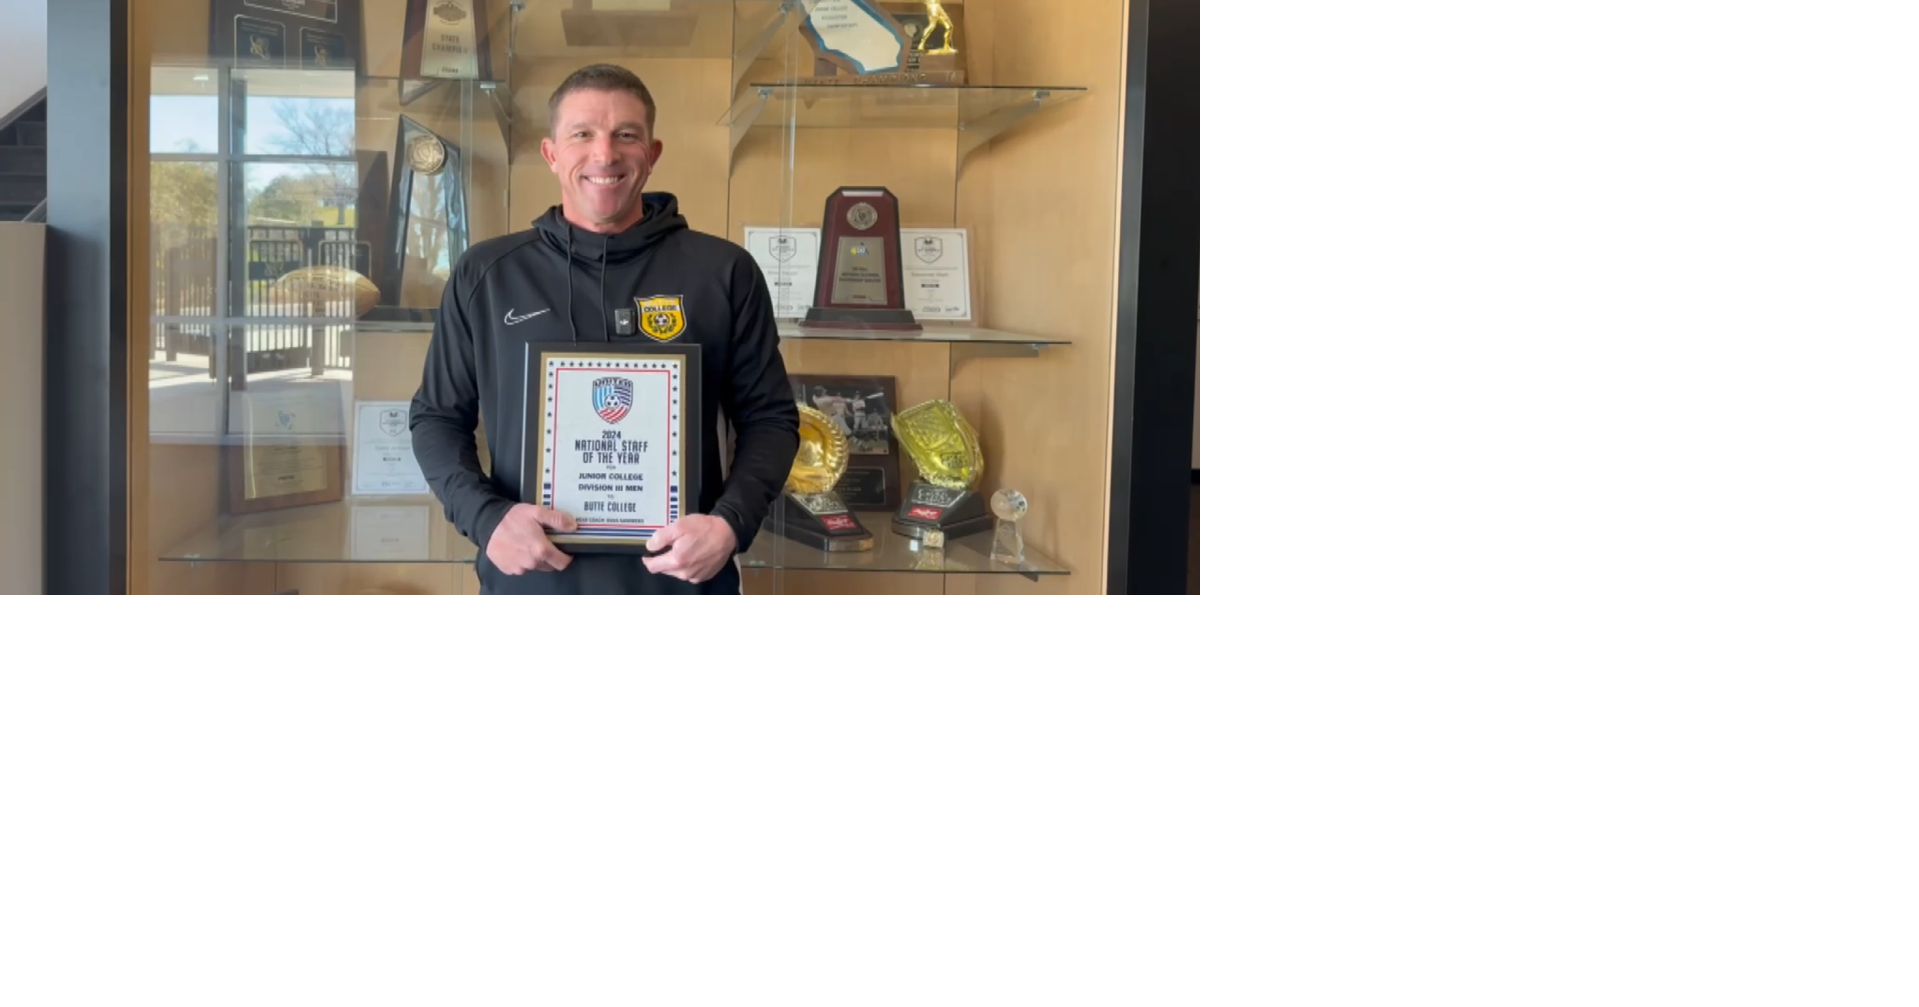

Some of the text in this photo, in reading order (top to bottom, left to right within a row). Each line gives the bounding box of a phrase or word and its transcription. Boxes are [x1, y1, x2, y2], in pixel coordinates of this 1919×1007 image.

[643, 304, 678, 312] COLLEGE
[602, 430, 621, 439] 2024
[575, 439, 648, 453] NATIONAL STAFF
[582, 452, 640, 465] OF THE YEAR
[578, 472, 644, 481] JUNIOR COLLEGE
[578, 483, 613, 491] DIVISION
[584, 501, 637, 513] BUTTE COLLEGE
